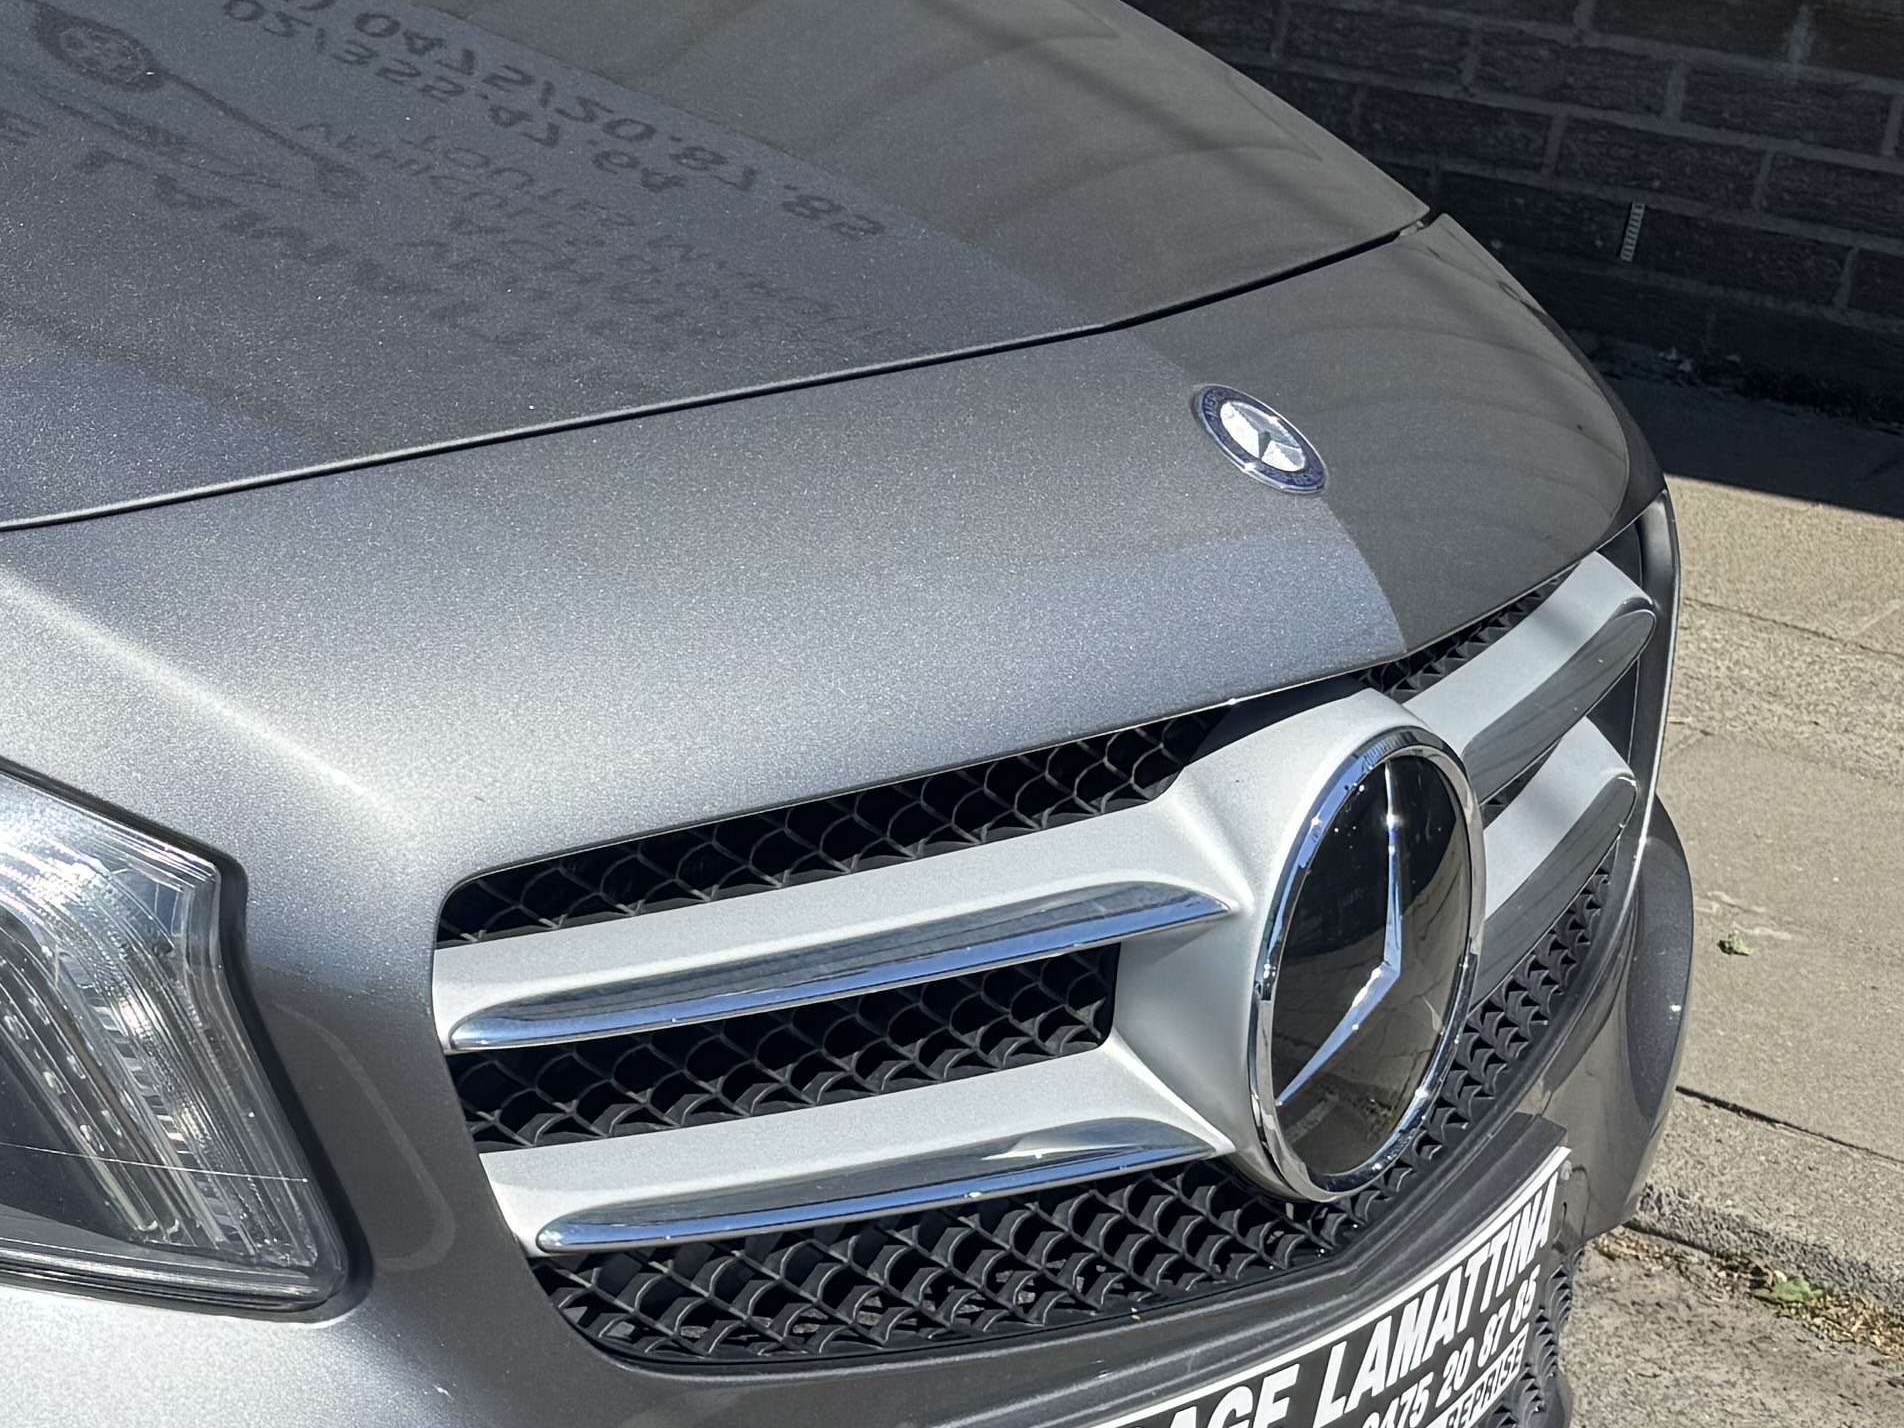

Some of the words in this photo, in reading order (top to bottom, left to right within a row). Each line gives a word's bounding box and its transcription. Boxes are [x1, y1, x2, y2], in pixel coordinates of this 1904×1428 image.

[1435, 1336, 1476, 1408] 20
[1477, 1298, 1511, 1369] 87
[1509, 1262, 1542, 1333] 85
